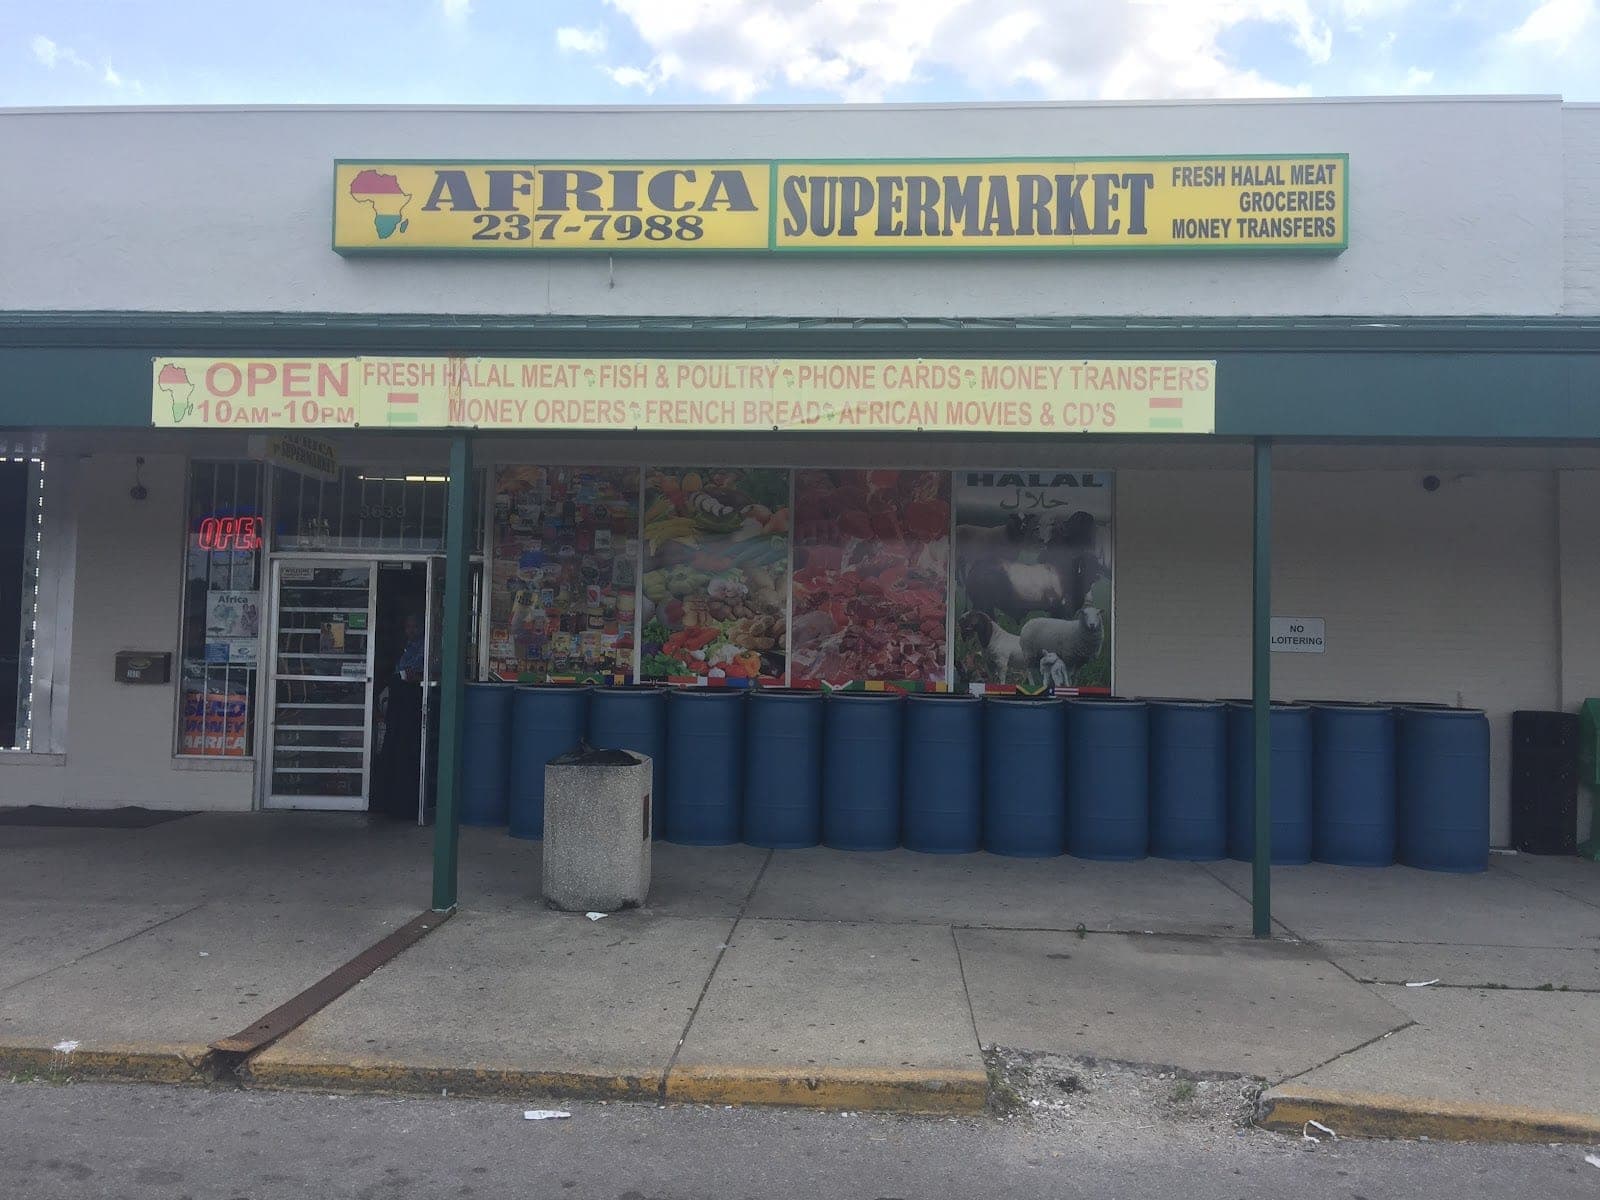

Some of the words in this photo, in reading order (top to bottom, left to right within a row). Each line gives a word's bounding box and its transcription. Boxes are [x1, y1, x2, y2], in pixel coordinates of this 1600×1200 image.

[1172, 166, 1226, 187] FRESH
[1231, 165, 1286, 186] HALAL
[1291, 164, 1336, 185] MEAT
[421, 170, 759, 211] AFRICA
[1239, 191, 1336, 212] GROCERIES
[783, 173, 1155, 237] SUPERMARKET
[472, 214, 704, 241] 237-7988
[1172, 218, 1232, 239] MONEY
[1237, 217, 1336, 238] TRANSFERS
[205, 362, 349, 398] OPEN
[363, 362, 435, 387] FRESH
[443, 362, 515, 387] HALAL
[521, 363, 582, 388] MEAT
[600, 364, 648, 389] FISH
[656, 365, 670, 388] &
[677, 365, 779, 389] POULTRY
[798, 365, 876, 389] PHONE
[883, 365, 961, 389] CARDS
[981, 366, 1063, 390] MONEY
[1070, 366, 1210, 391] TRANSFERS
[197, 400, 356, 424] 10AM-10PM
[449, 399, 529, 424] MONEY
[534, 400, 626, 424] ORDERS
[646, 400, 736, 425] FRENCH
[743, 400, 820, 425] BREAD
[838, 400, 938, 425] AFRICAN
[946, 401, 1033, 425] MOVIES
[1039, 402, 1055, 426] &
[1063, 402, 1117, 427] CD'S
[967, 473, 1104, 487] HALAL
[218, 595, 248, 604] Africa
[1271, 636, 1323, 645] LOITERING
[1289, 625, 1304, 633] NO
[184, 736, 246, 749] AFRICA
